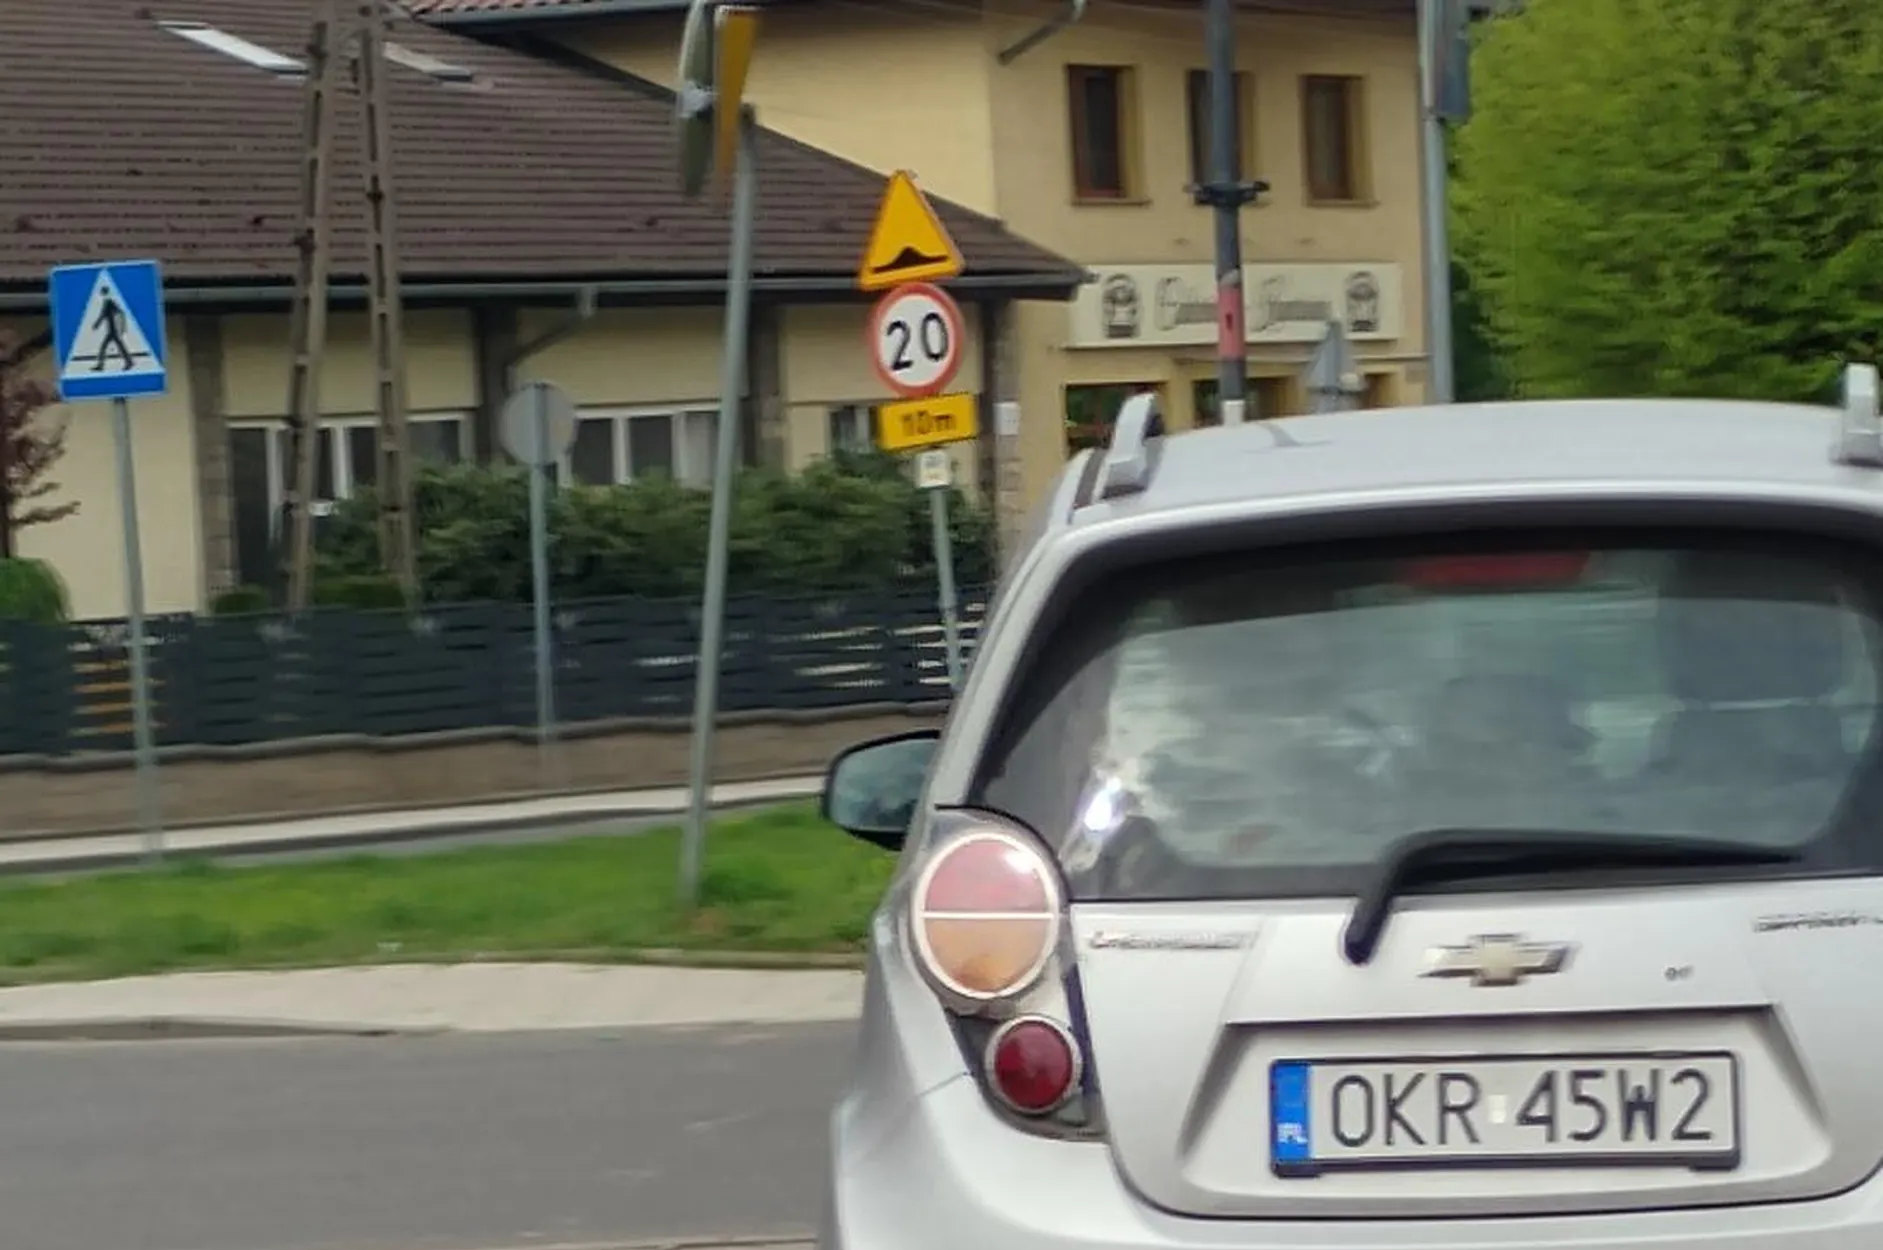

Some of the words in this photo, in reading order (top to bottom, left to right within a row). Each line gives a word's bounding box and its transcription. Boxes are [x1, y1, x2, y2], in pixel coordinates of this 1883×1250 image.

[886, 311, 949, 371] 20
[1332, 1072, 1481, 1147] OKR
[1515, 1069, 1714, 1143] 45W2
